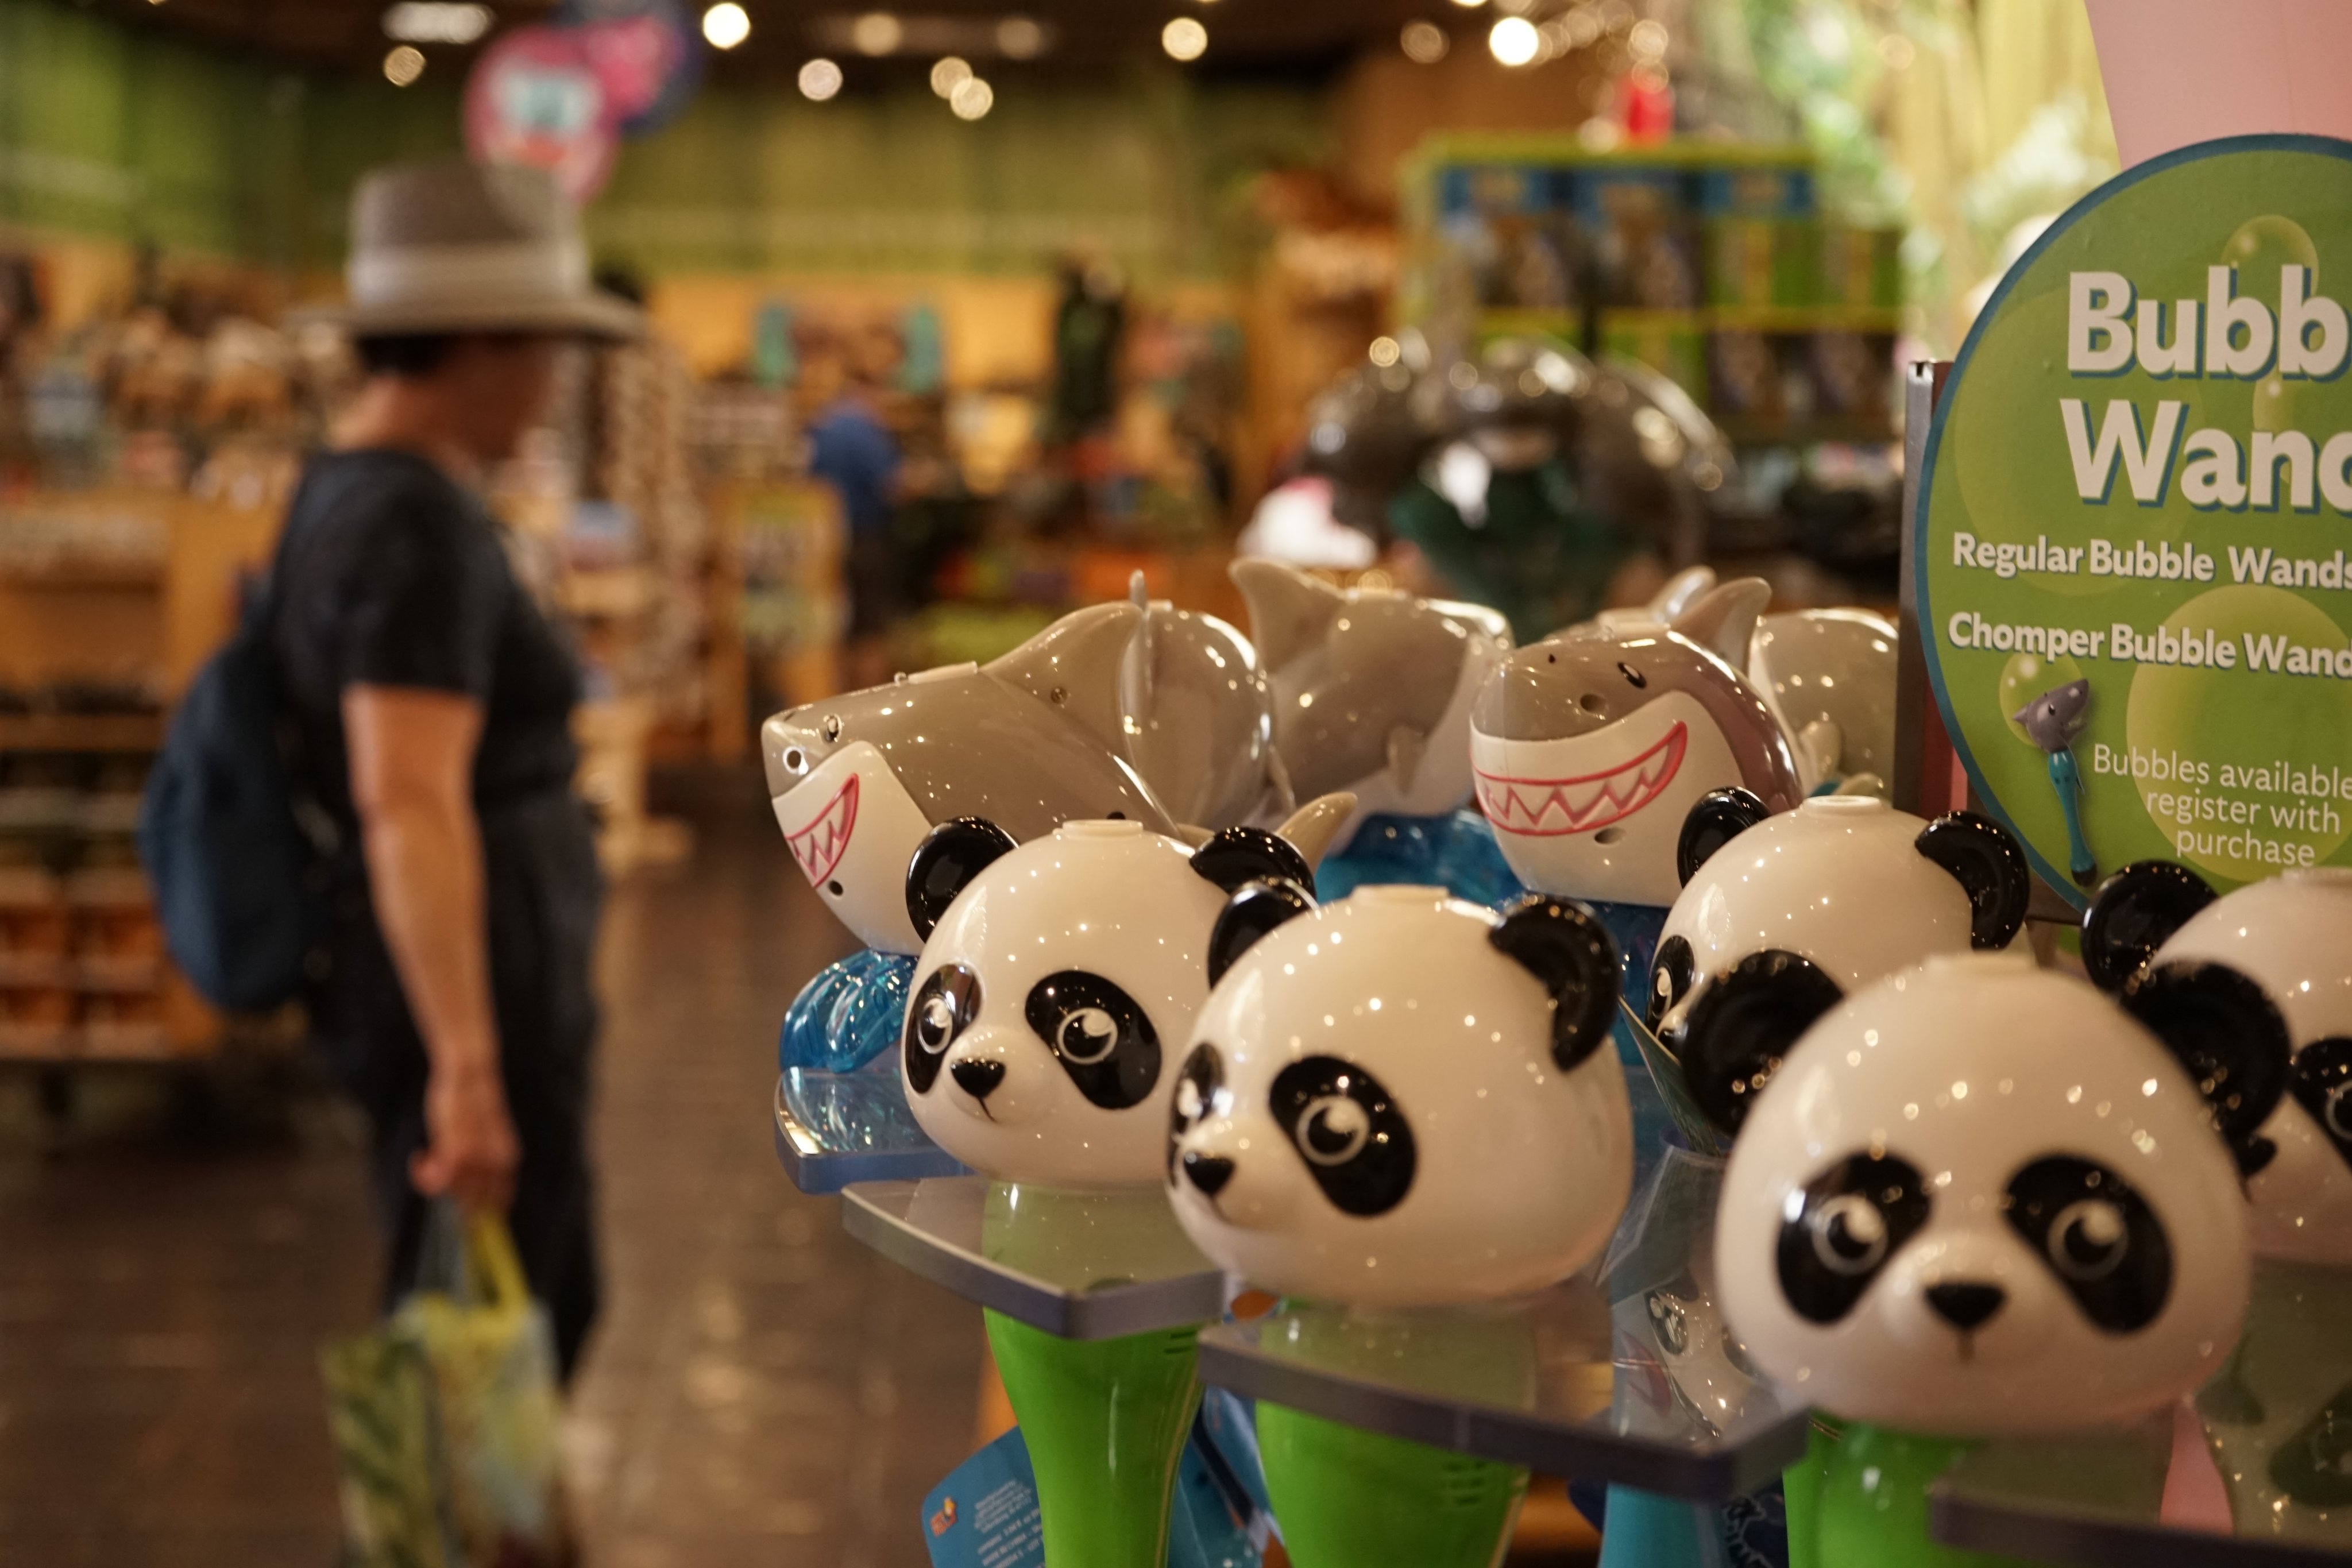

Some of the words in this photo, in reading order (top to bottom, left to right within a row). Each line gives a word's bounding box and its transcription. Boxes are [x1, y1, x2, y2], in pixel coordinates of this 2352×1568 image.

[2068, 264, 2350, 379] Bubb
[1953, 532, 2084, 578] Regular
[2089, 539, 2215, 581] Bubble
[1948, 612, 2104, 663] Chomper
[2110, 624, 2237, 669] Bubble
[2094, 744, 2210, 785] Bubbles
[2147, 789, 2261, 825] register
[2270, 799, 2340, 834] with
[2176, 830, 2315, 867] purchase
